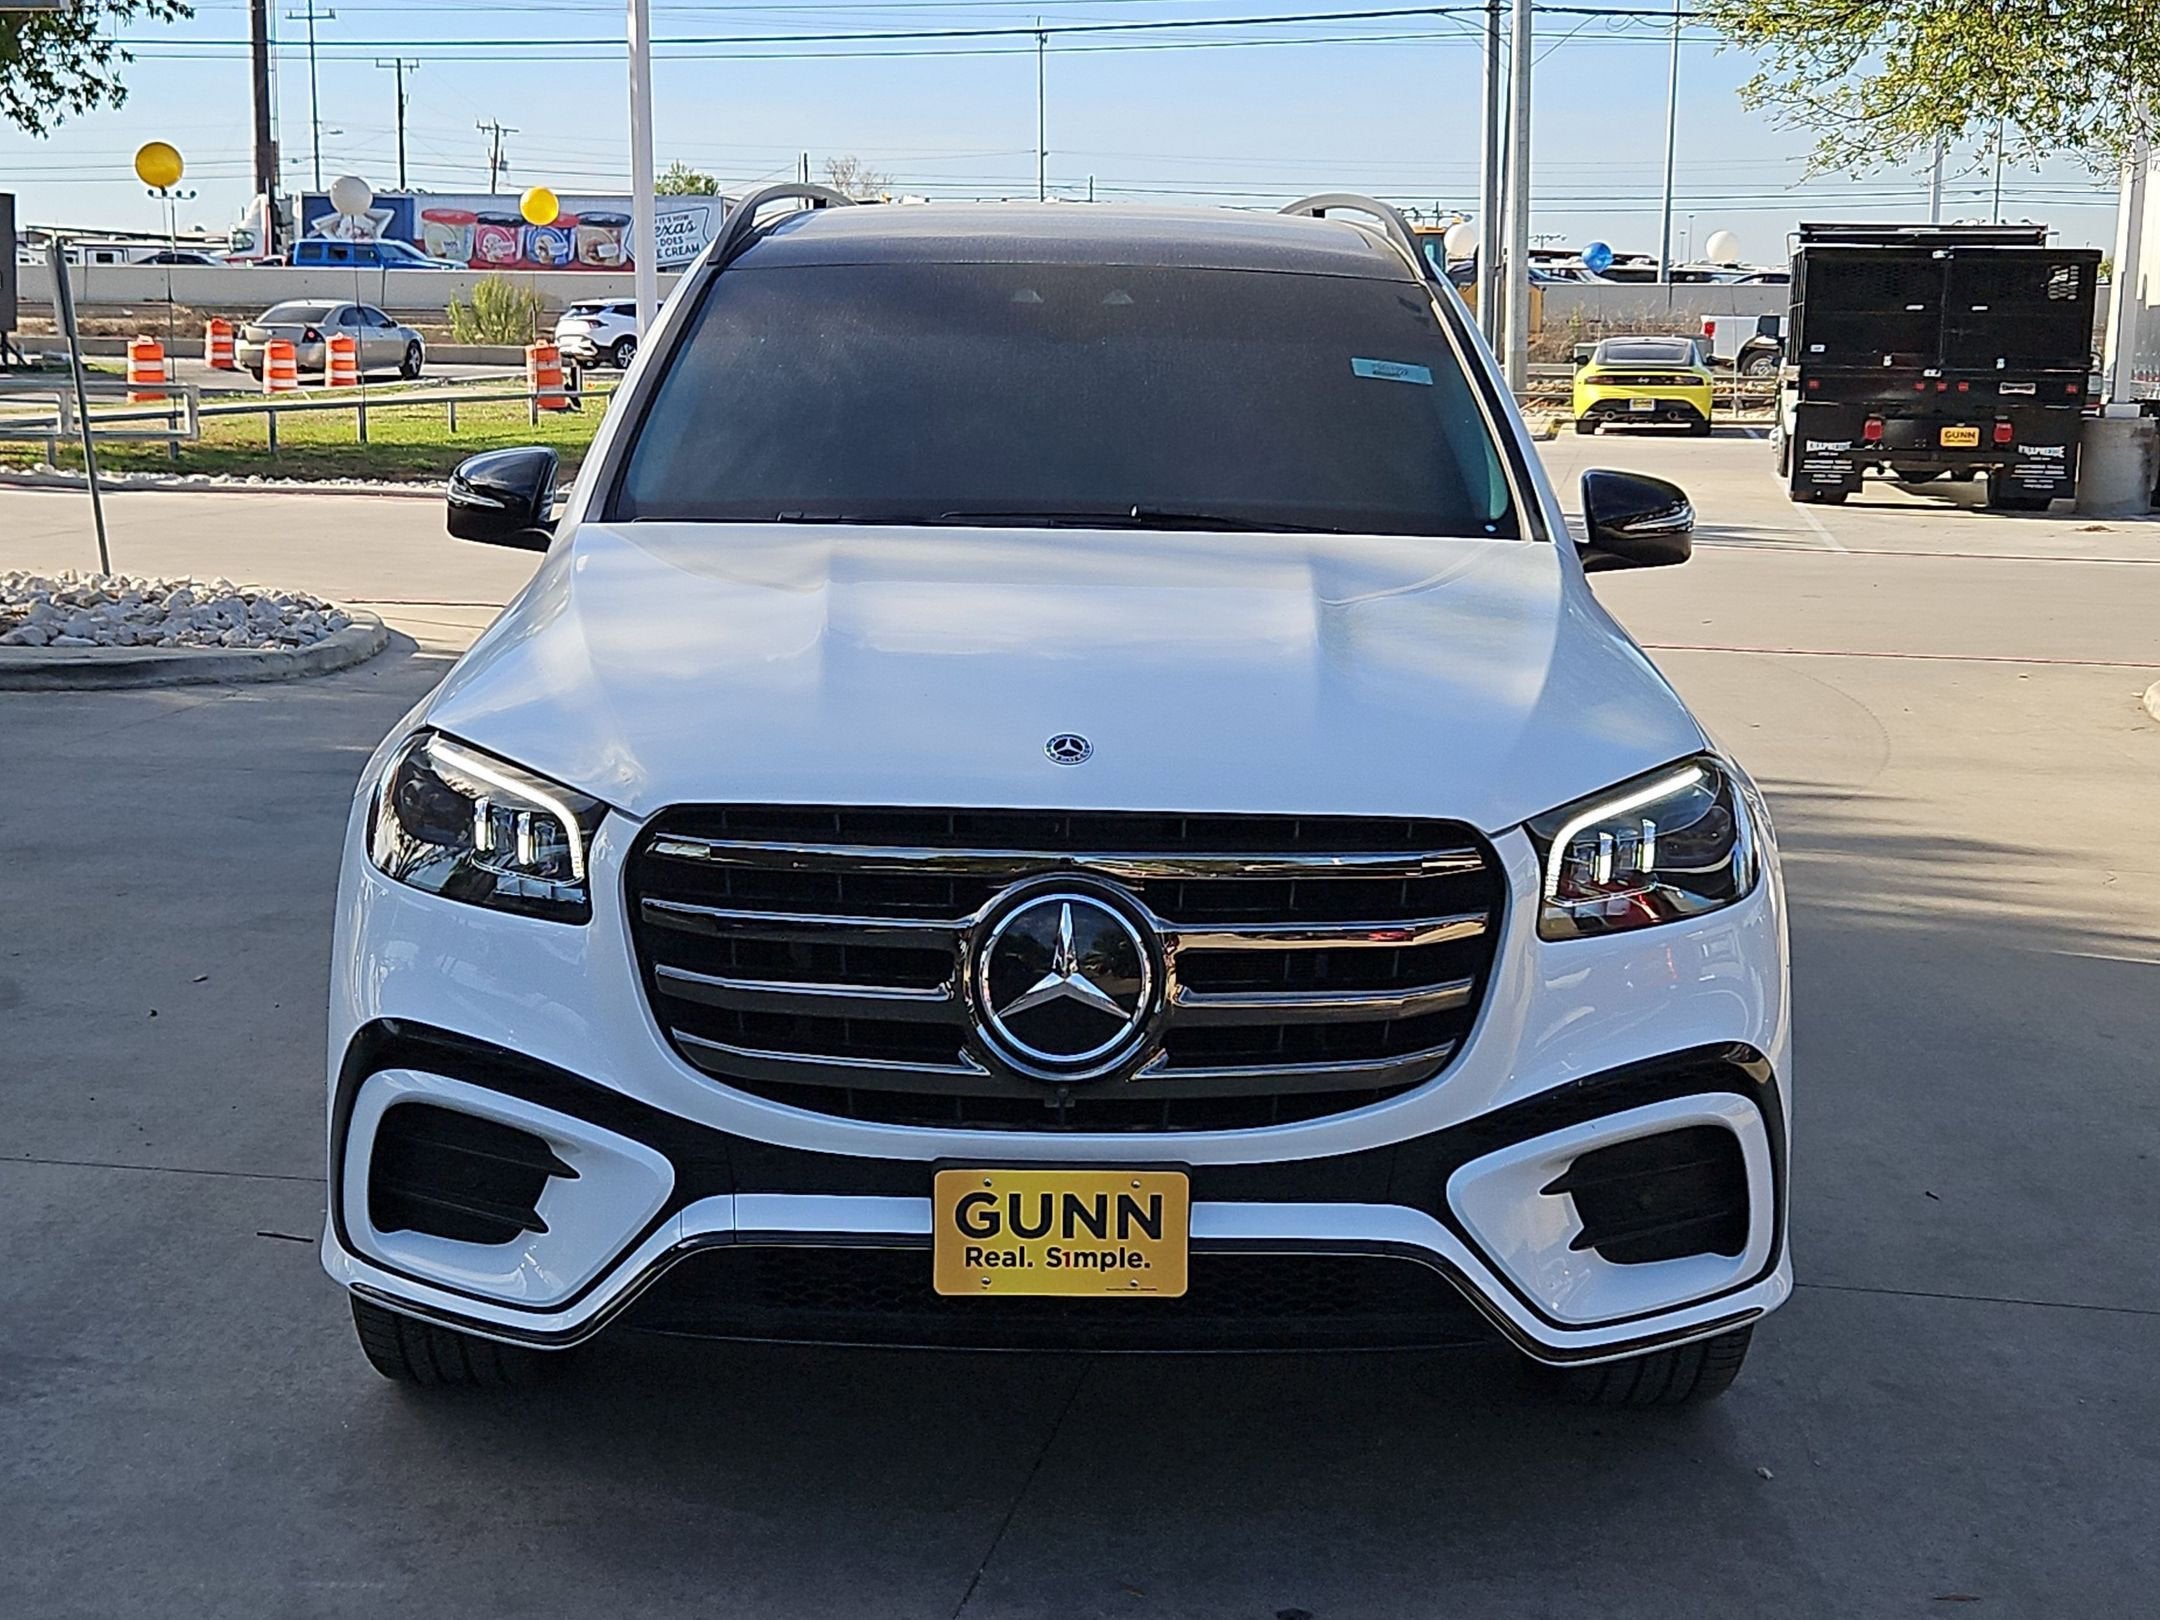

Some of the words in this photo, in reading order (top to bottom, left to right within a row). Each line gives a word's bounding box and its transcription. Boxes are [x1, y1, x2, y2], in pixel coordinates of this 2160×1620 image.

[655, 220, 697, 237] exas
[660, 235, 684, 246] DOES
[665, 243, 700, 258] CREAM
[1944, 431, 1976, 439] GUNN
[955, 1191, 1163, 1240] GUNN
[965, 1246, 1033, 1269] Real.
